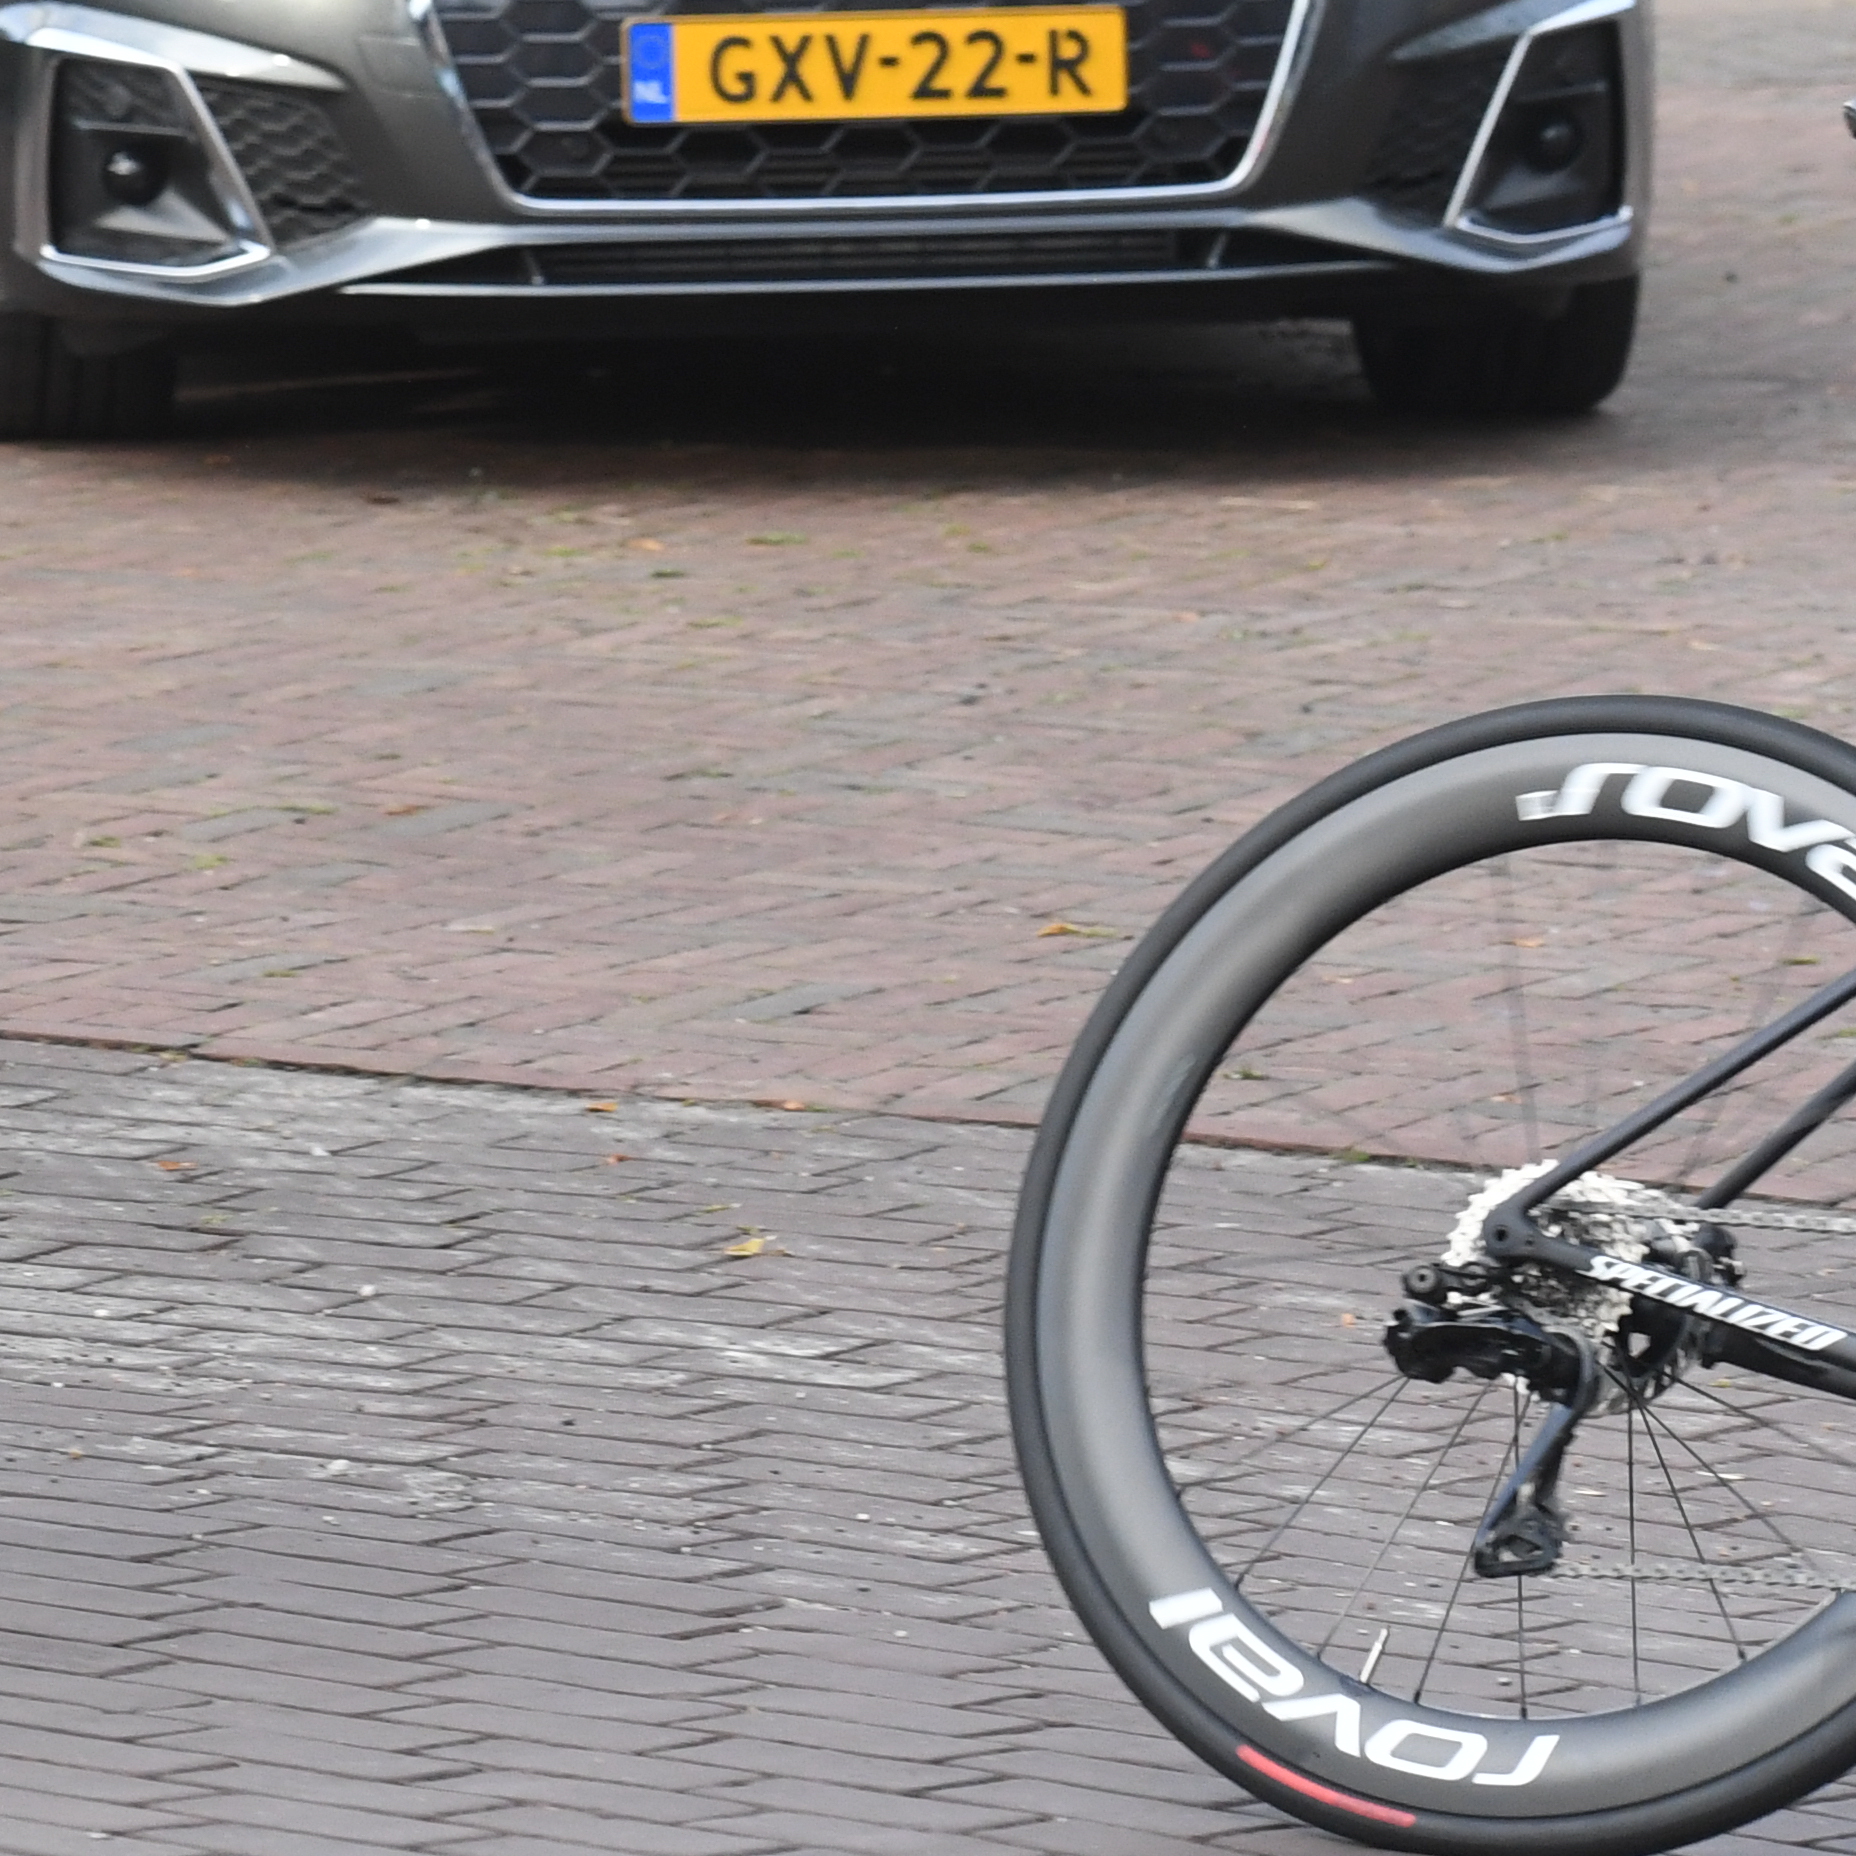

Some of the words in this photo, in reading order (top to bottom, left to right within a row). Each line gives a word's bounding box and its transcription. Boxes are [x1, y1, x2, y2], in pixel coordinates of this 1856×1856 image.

[708, 28, 1094, 107] GXV-22-R
[1573, 1254, 1849, 1352] SPECIALIZED
[1148, 1587, 1562, 1788] roval
